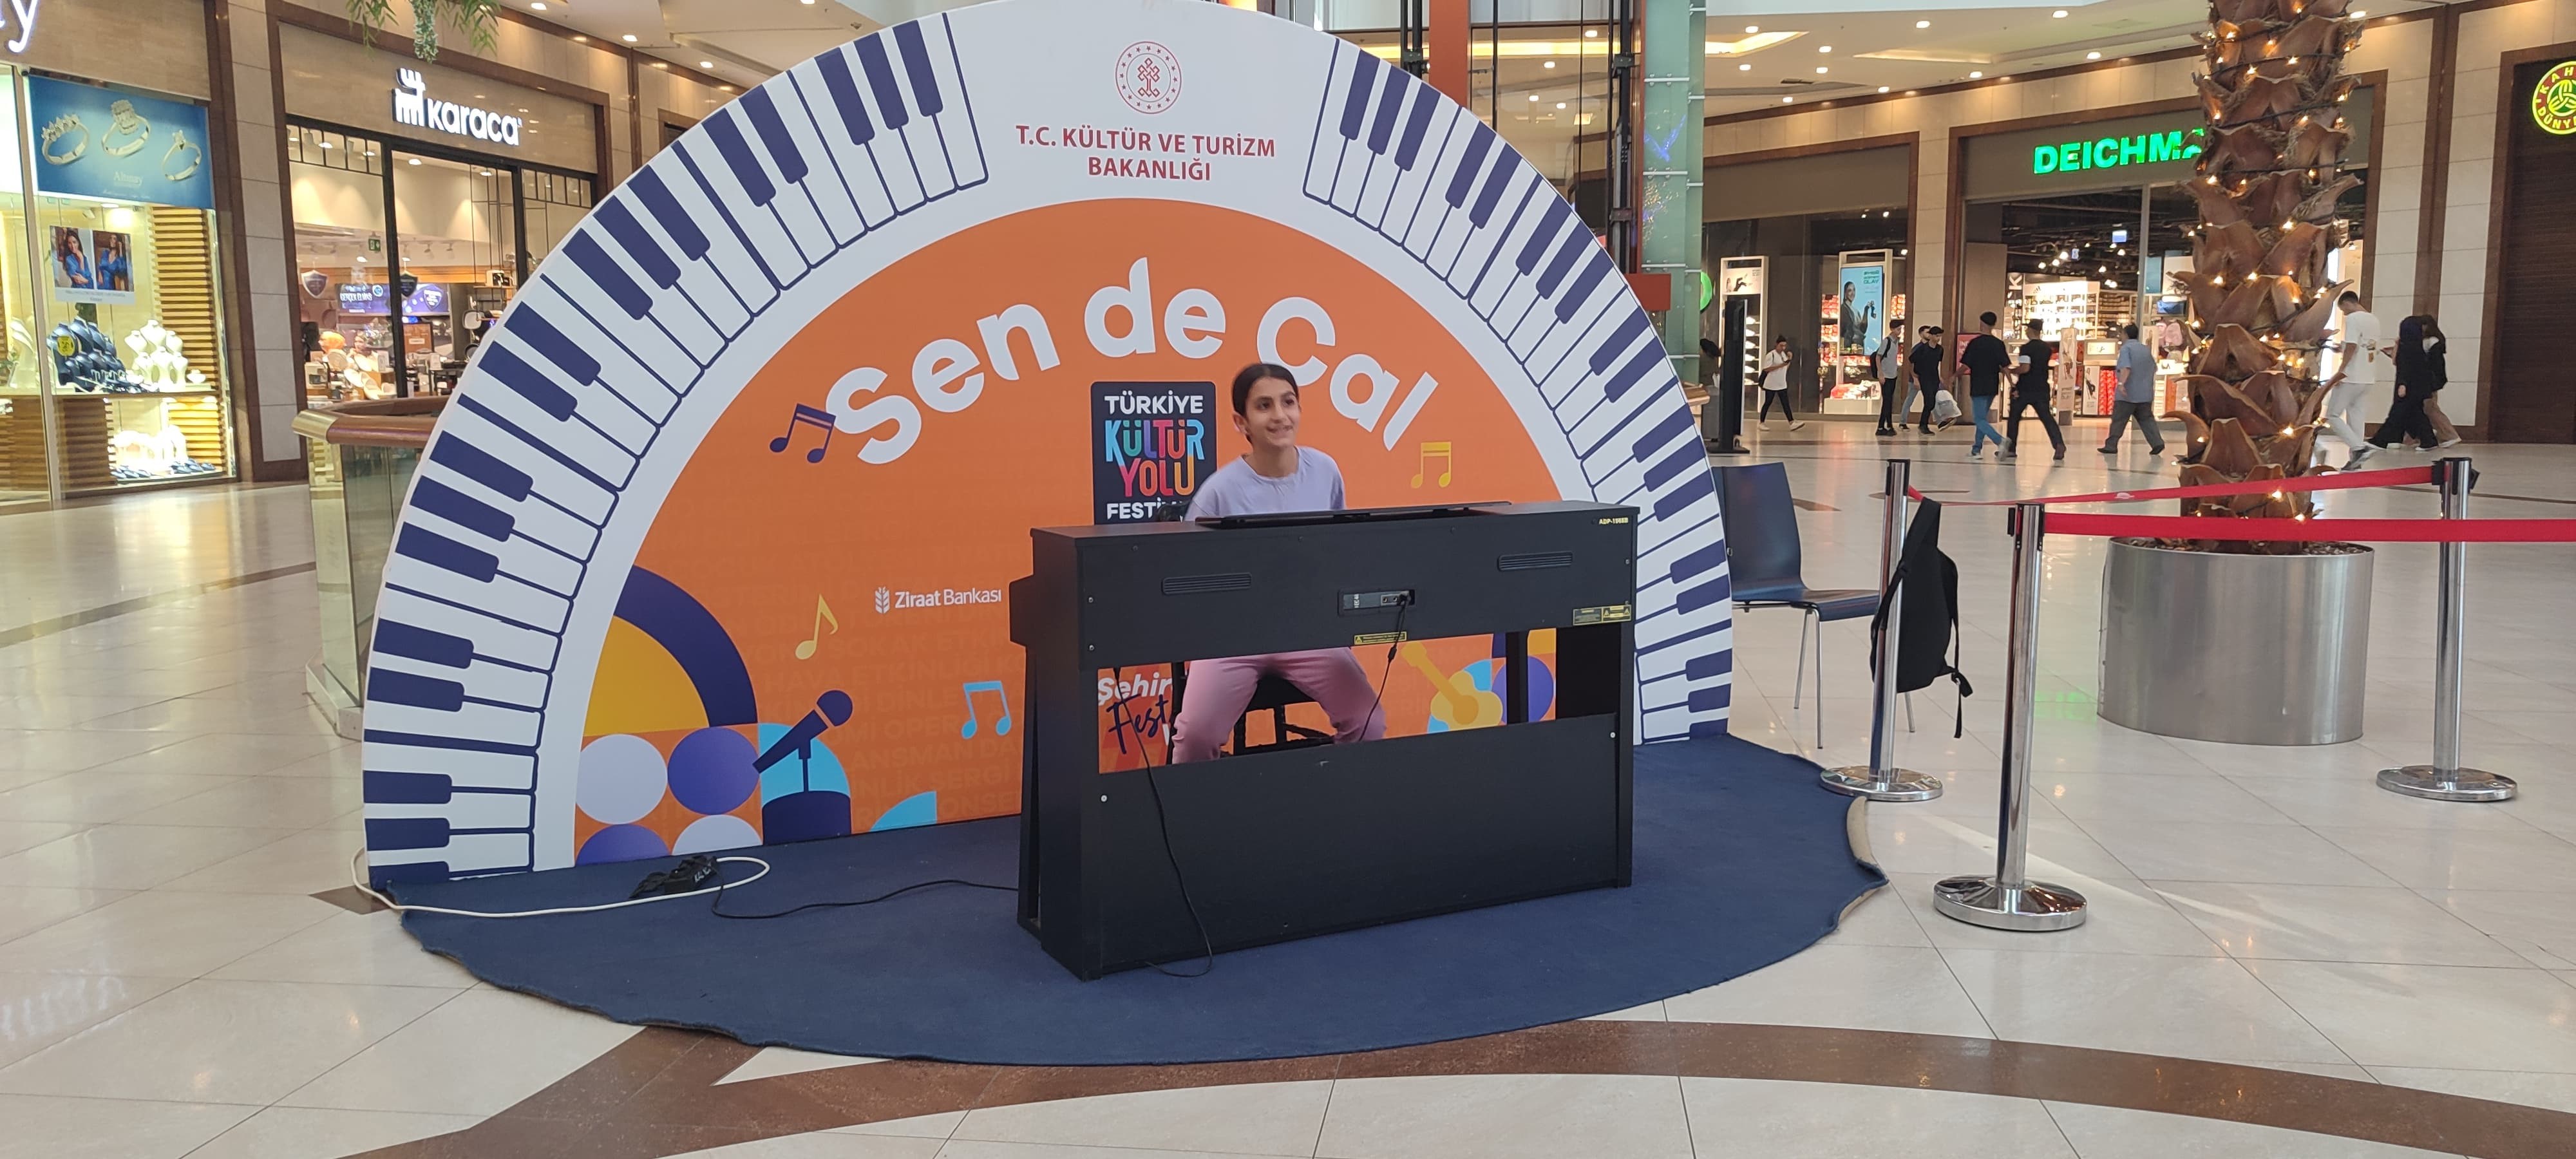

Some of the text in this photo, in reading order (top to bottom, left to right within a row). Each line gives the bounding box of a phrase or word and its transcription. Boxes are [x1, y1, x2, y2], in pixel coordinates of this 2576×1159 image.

[427, 97, 520, 146] karaca
[1016, 124, 1276, 158] T.C. KÜLTÜR VE TURİZM
[1088, 156, 1211, 182] BAKANLIĞI
[826, 256, 1440, 465] Sen de Cal
[1104, 390, 1204, 415] TÜRKİYE
[1104, 419, 1206, 465] KÜLTÜR
[1119, 456, 1195, 498] YOLU
[895, 587, 1001, 608] Ziraat Bankası
[1098, 672, 1173, 706] Şehir
[1106, 693, 1169, 755] Fest
